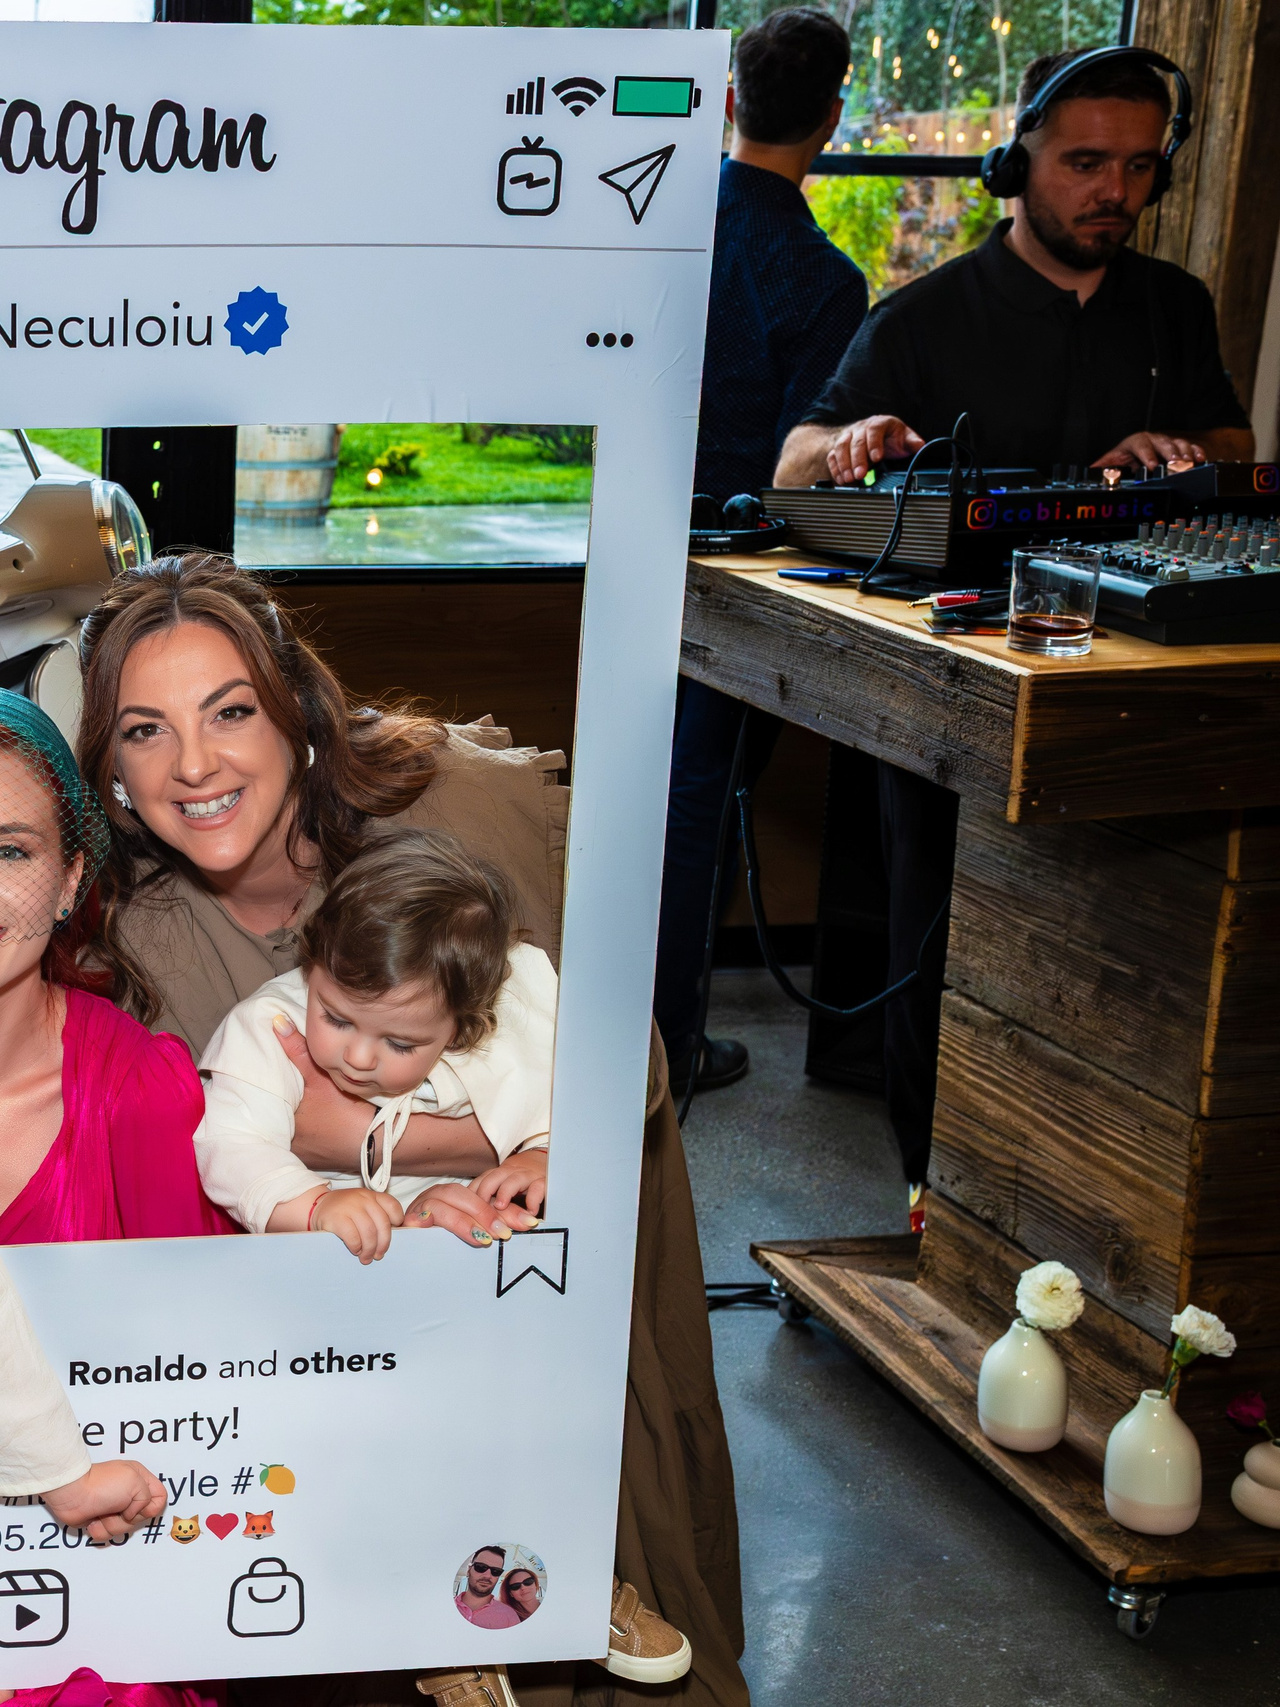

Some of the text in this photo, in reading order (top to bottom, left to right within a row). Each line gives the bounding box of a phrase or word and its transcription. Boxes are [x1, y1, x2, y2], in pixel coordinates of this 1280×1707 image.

[1002, 498, 1154, 522] cobi.music
[69, 1354, 207, 1386] Ronaldo
[219, 1349, 277, 1379] and
[289, 1346, 397, 1375] others
[119, 1406, 240, 1454] party!
